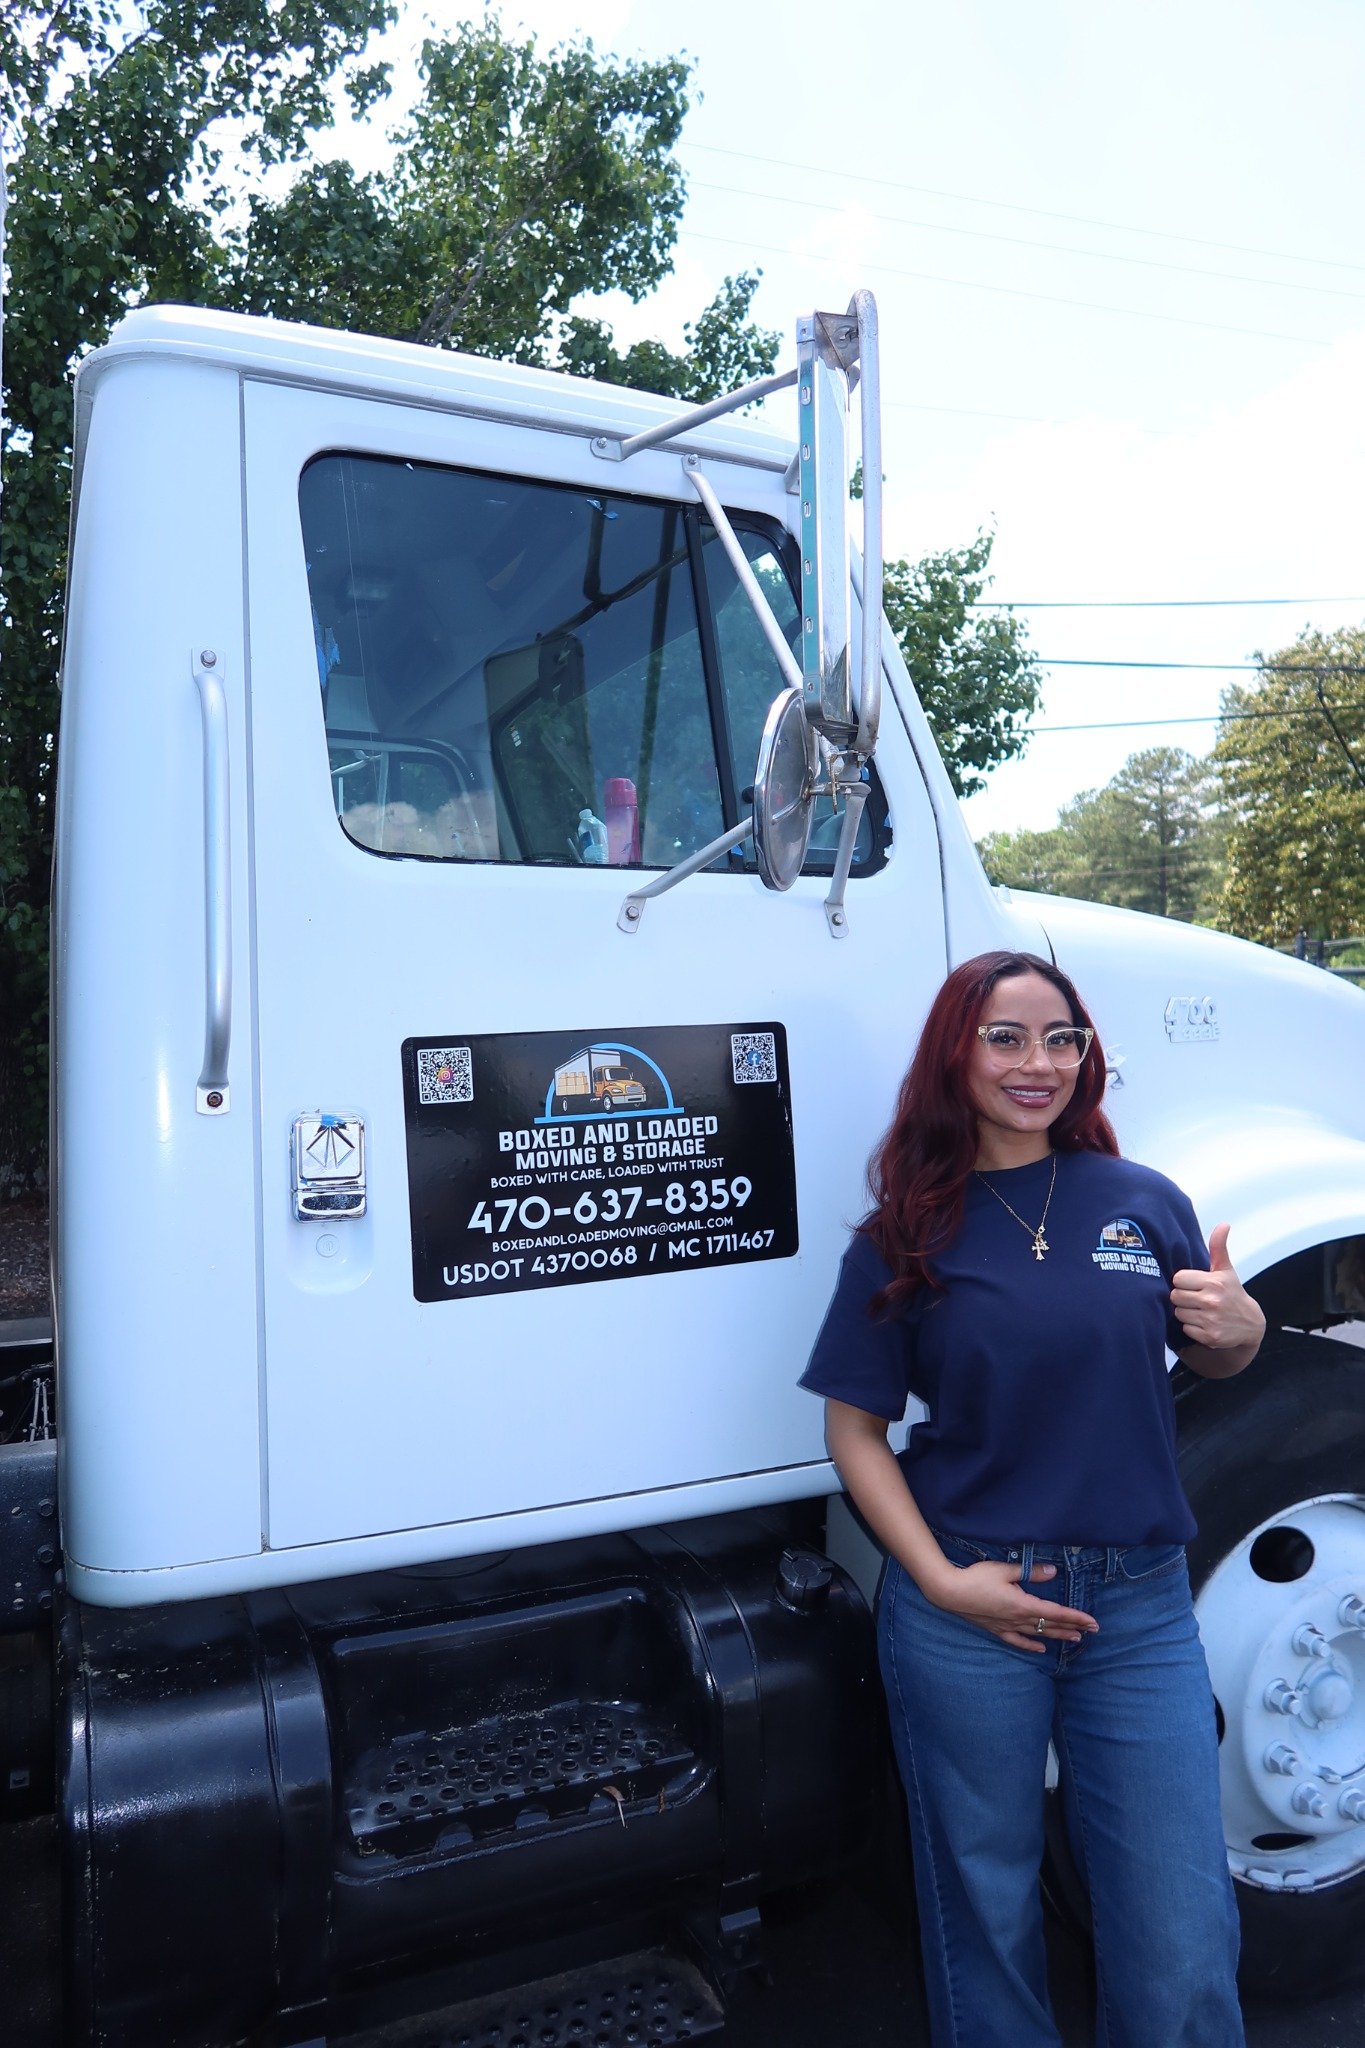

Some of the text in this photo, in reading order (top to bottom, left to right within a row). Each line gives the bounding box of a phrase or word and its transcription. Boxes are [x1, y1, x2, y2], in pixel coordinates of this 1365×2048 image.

[499, 1116, 718, 1152] BOXED AND LOADED
[516, 1138, 706, 1170] MOVING & STORAGE
[491, 1157, 724, 1188] BOXED WITH CARE, LOADED WITH TRUST
[467, 1176, 752, 1234] 470-637-8359
[492, 1216, 733, 1252] BOXEDANDLOADEDMOVING@GMAIL.COM
[443, 1229, 774, 1286] USDOT 4370068 / MC 1711467
[1092, 1253, 1120, 1263] BOXED
[1122, 1254, 1137, 1263] AND
[1100, 1262, 1129, 1271] MOVING
[1136, 1265, 1160, 1277] STORAGE
